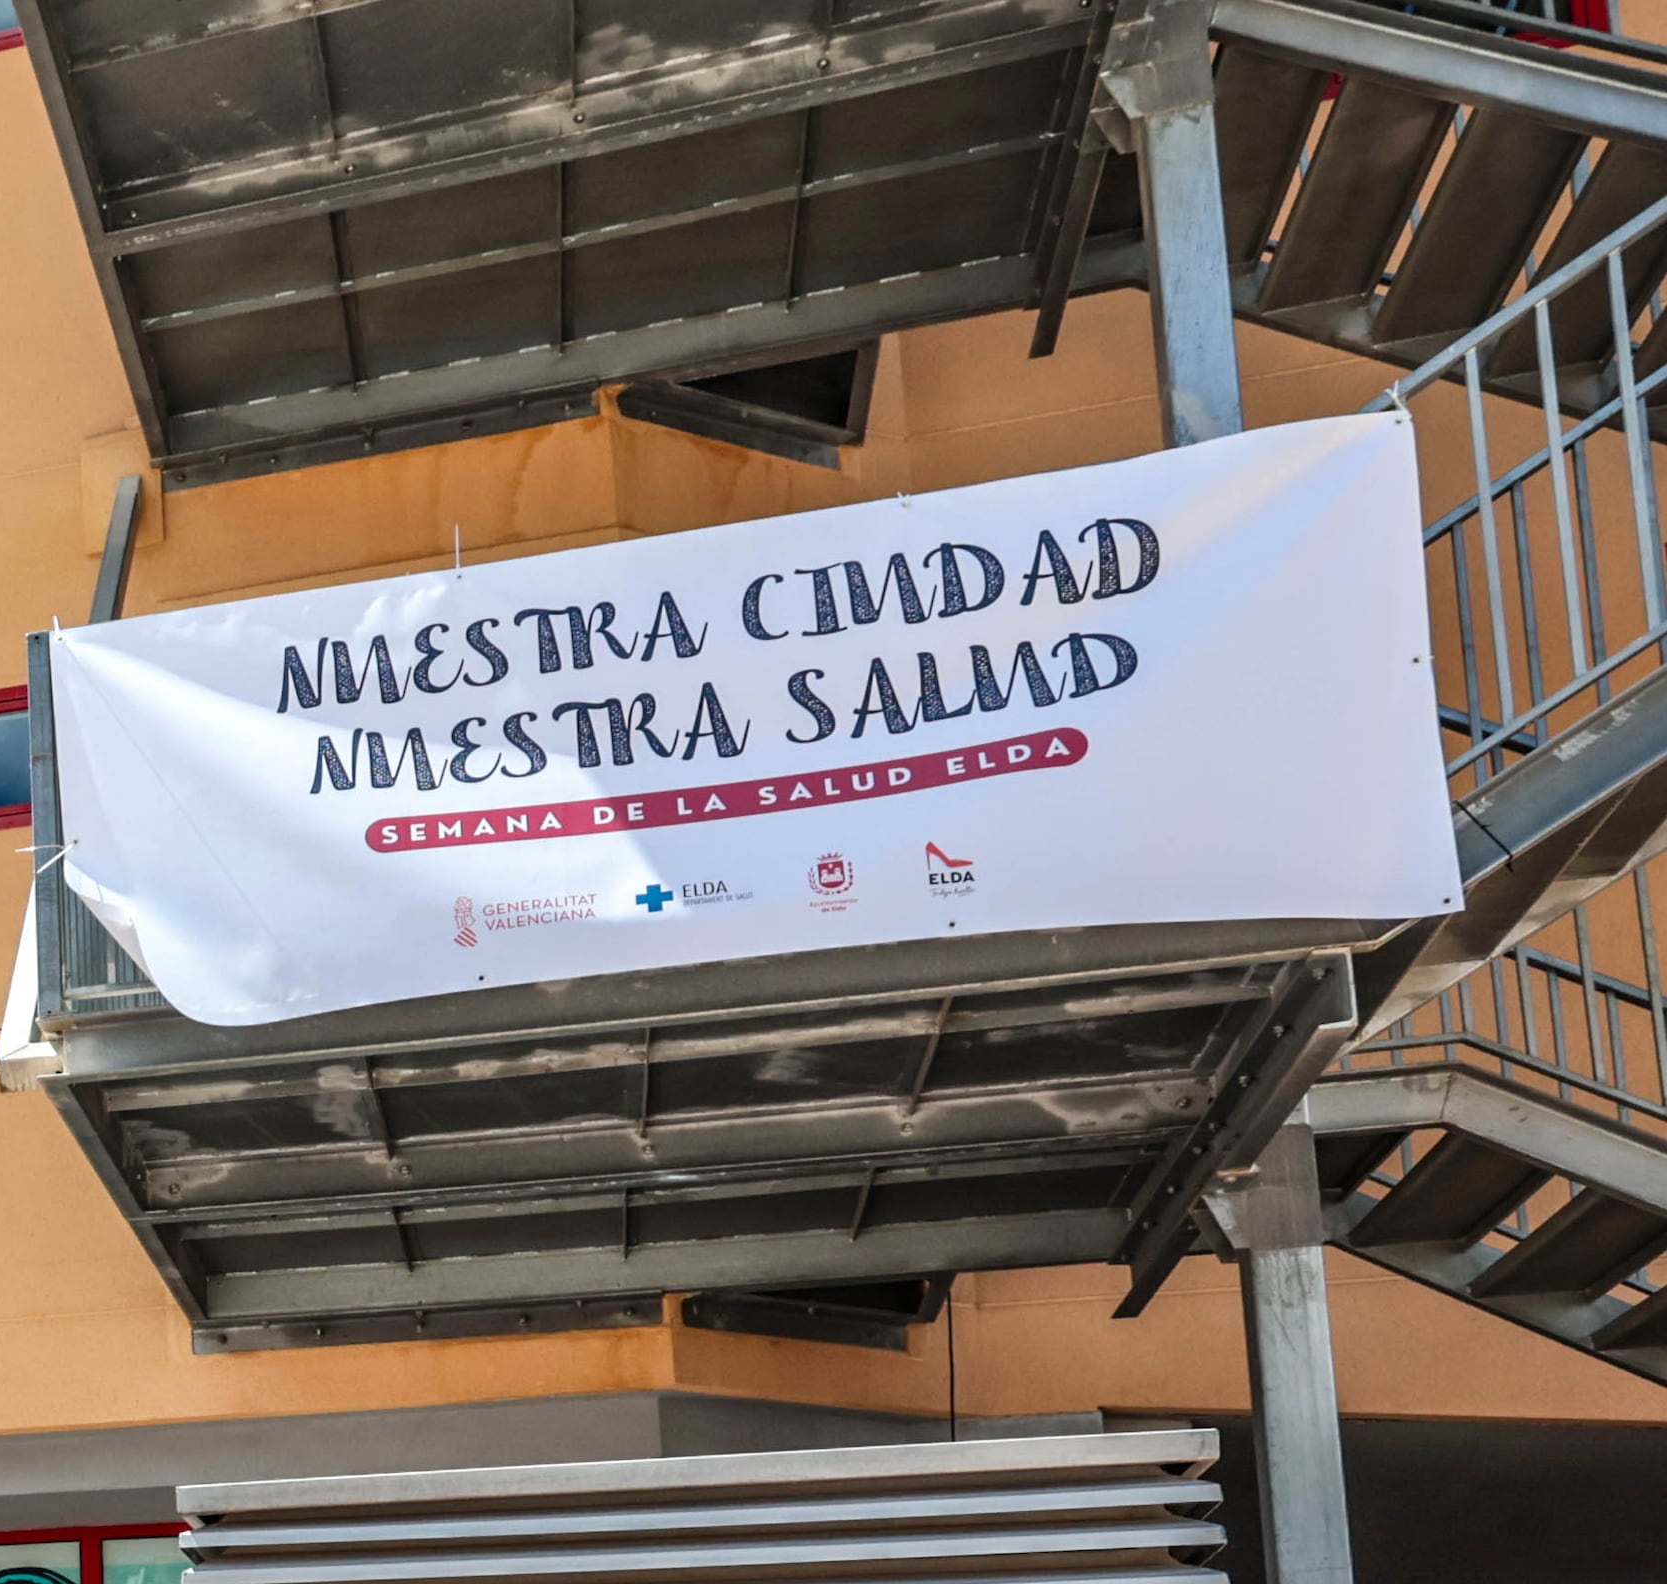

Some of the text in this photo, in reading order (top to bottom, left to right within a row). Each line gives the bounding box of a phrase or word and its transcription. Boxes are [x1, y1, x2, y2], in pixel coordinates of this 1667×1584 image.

[277, 518, 1160, 713] NUESTRA CIUDAD
[310, 632, 1138, 794] NUESTRA SALUD
[381, 736, 1071, 844] SEMANA DE LA SALUD ELDA
[682, 880, 728, 898] ELDA
[929, 871, 975, 885] ELDA
[482, 893, 597, 917] GENERALITAT
[484, 908, 596, 931] VALENCIANA
